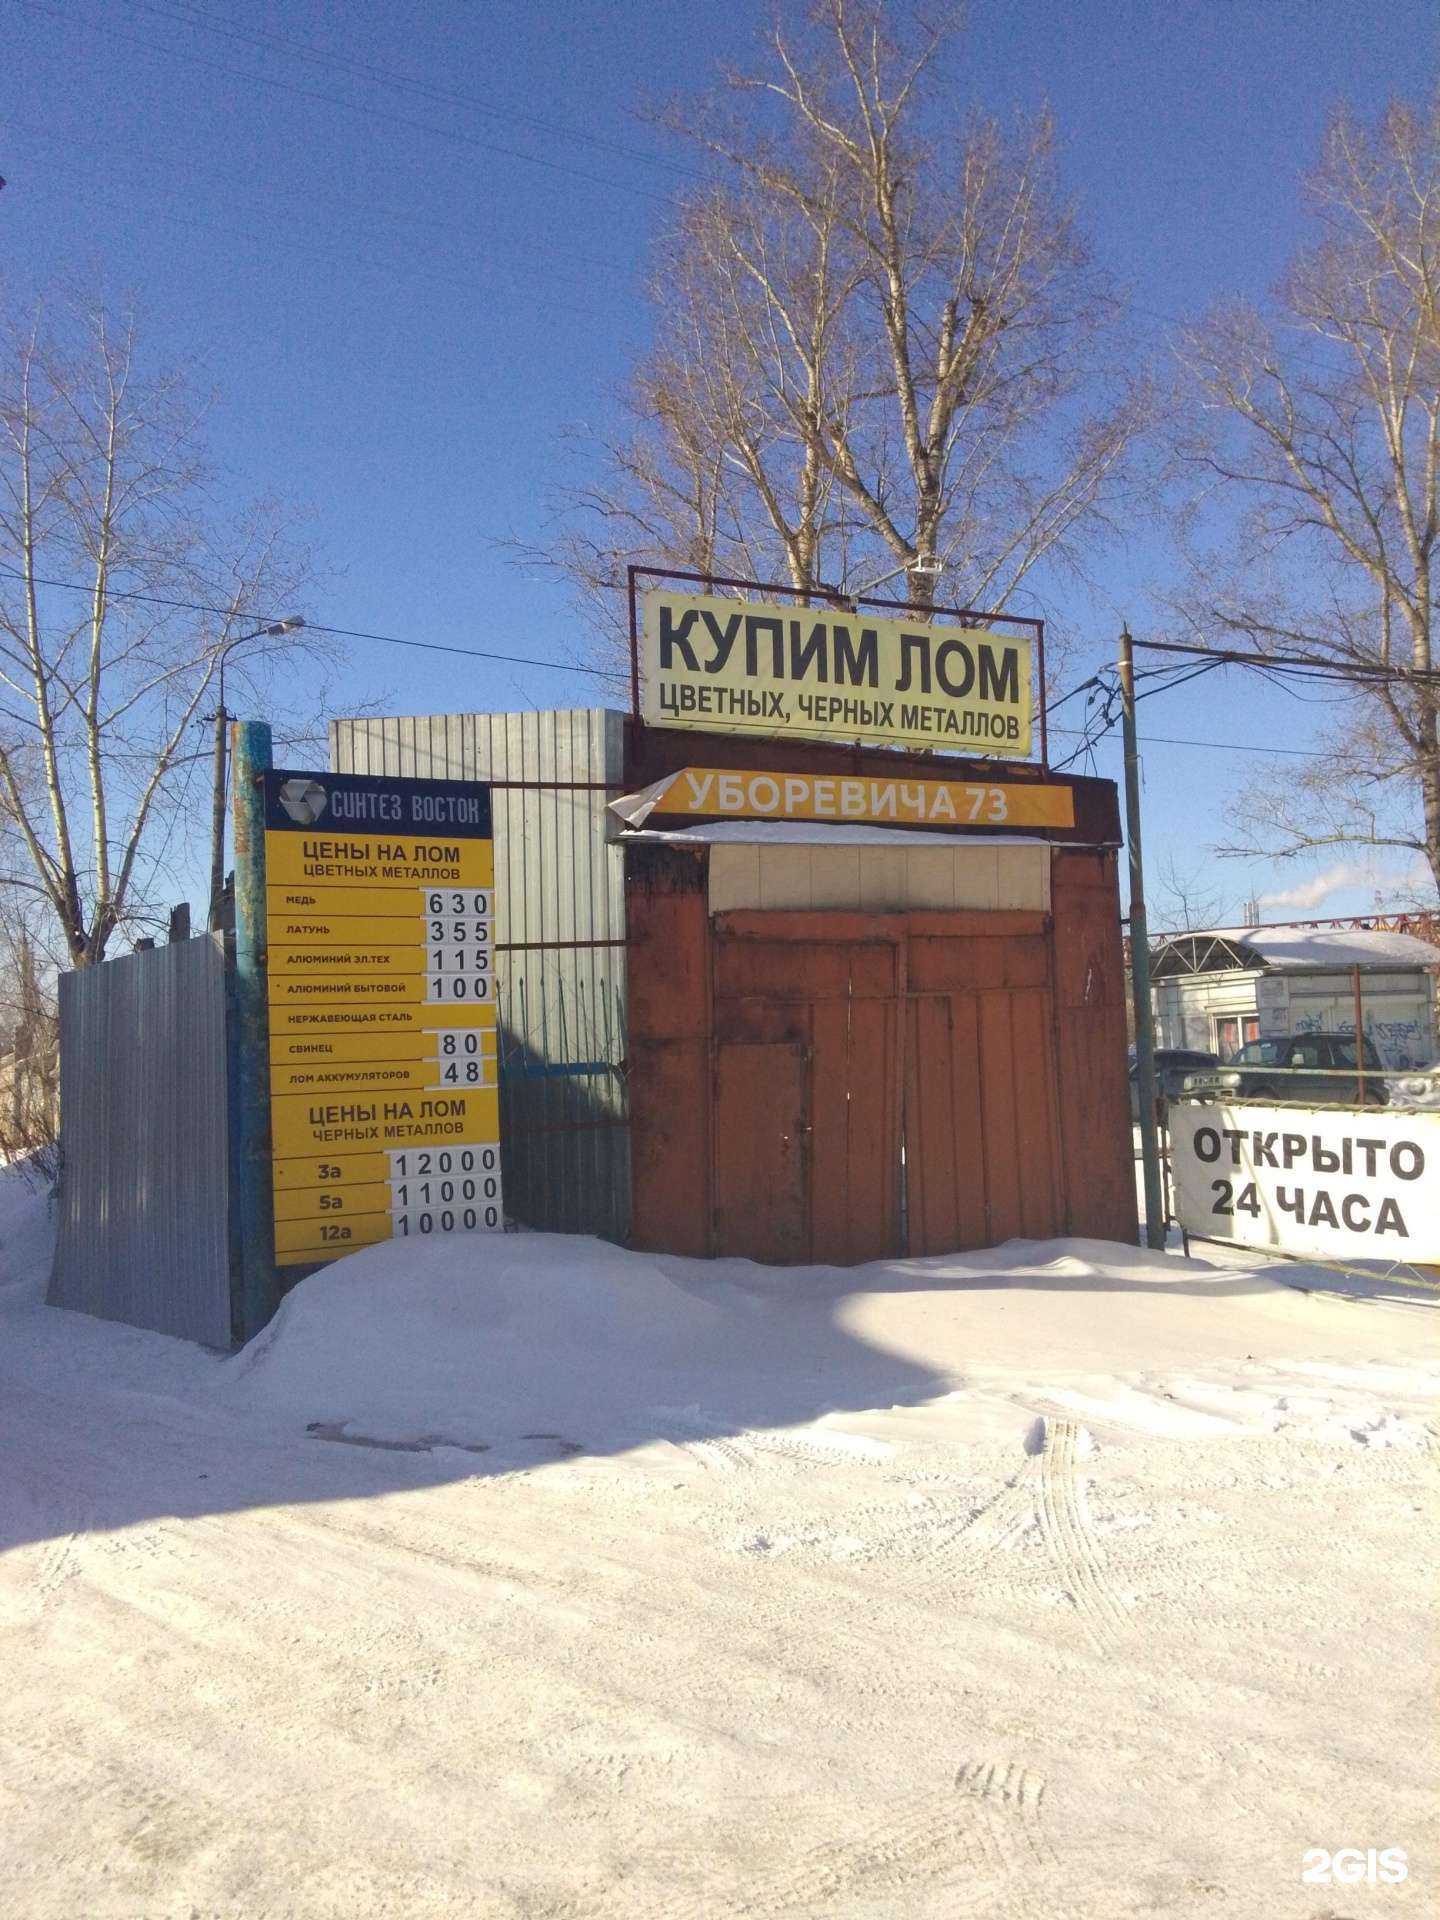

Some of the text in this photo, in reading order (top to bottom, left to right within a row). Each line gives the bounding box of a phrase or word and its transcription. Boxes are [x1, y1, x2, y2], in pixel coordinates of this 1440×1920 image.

[660, 606, 1019, 703] КУПИМ ЛОМ
[660, 683, 1020, 739] ЦВЕТНЫХ, ЧЕРНЫХ МЕТАЛЛОВ
[685, 773, 1008, 820] УБОРЕВИЧА 73
[412, 796, 479, 823] ВОСТОК
[303, 841, 460, 862] ЦЕНЫ НА ЛОМ
[304, 865, 460, 879] ЦВЕТНЫХ МЕТАЛЛОВ
[286, 894, 486, 913] МЕДЬ 630
[286, 922, 487, 941] ЛАТУНЬ 355
[287, 950, 488, 969] АЛЮМИНИЙ ЭЛ.ТЕХ 115
[288, 979, 486, 998] АЛЮМИНИЙ БЫТОВОЙ 100
[288, 1013, 412, 1023] НЕРЖАВЕЮЩАЯ СТАЛЬ
[289, 1034, 477, 1054] СВИНЕЦ 80
[317, 1071, 409, 1082] АККУМУЛЯТОРОВ
[444, 1062, 478, 1082] 48
[310, 1100, 465, 1125] ЦЕНЫ НА ЛОМ
[313, 1122, 463, 1141] ЧЕРНЫХ МЕТАЛЛОВ
[396, 1149, 494, 1175] 12000
[1193, 1127, 1425, 1180] ОТКРЫТО
[319, 1178, 496, 1209] 5а 11000
[1211, 1179, 1409, 1238] 24 ЧАСА
[320, 1207, 497, 1240] 12а 10000
